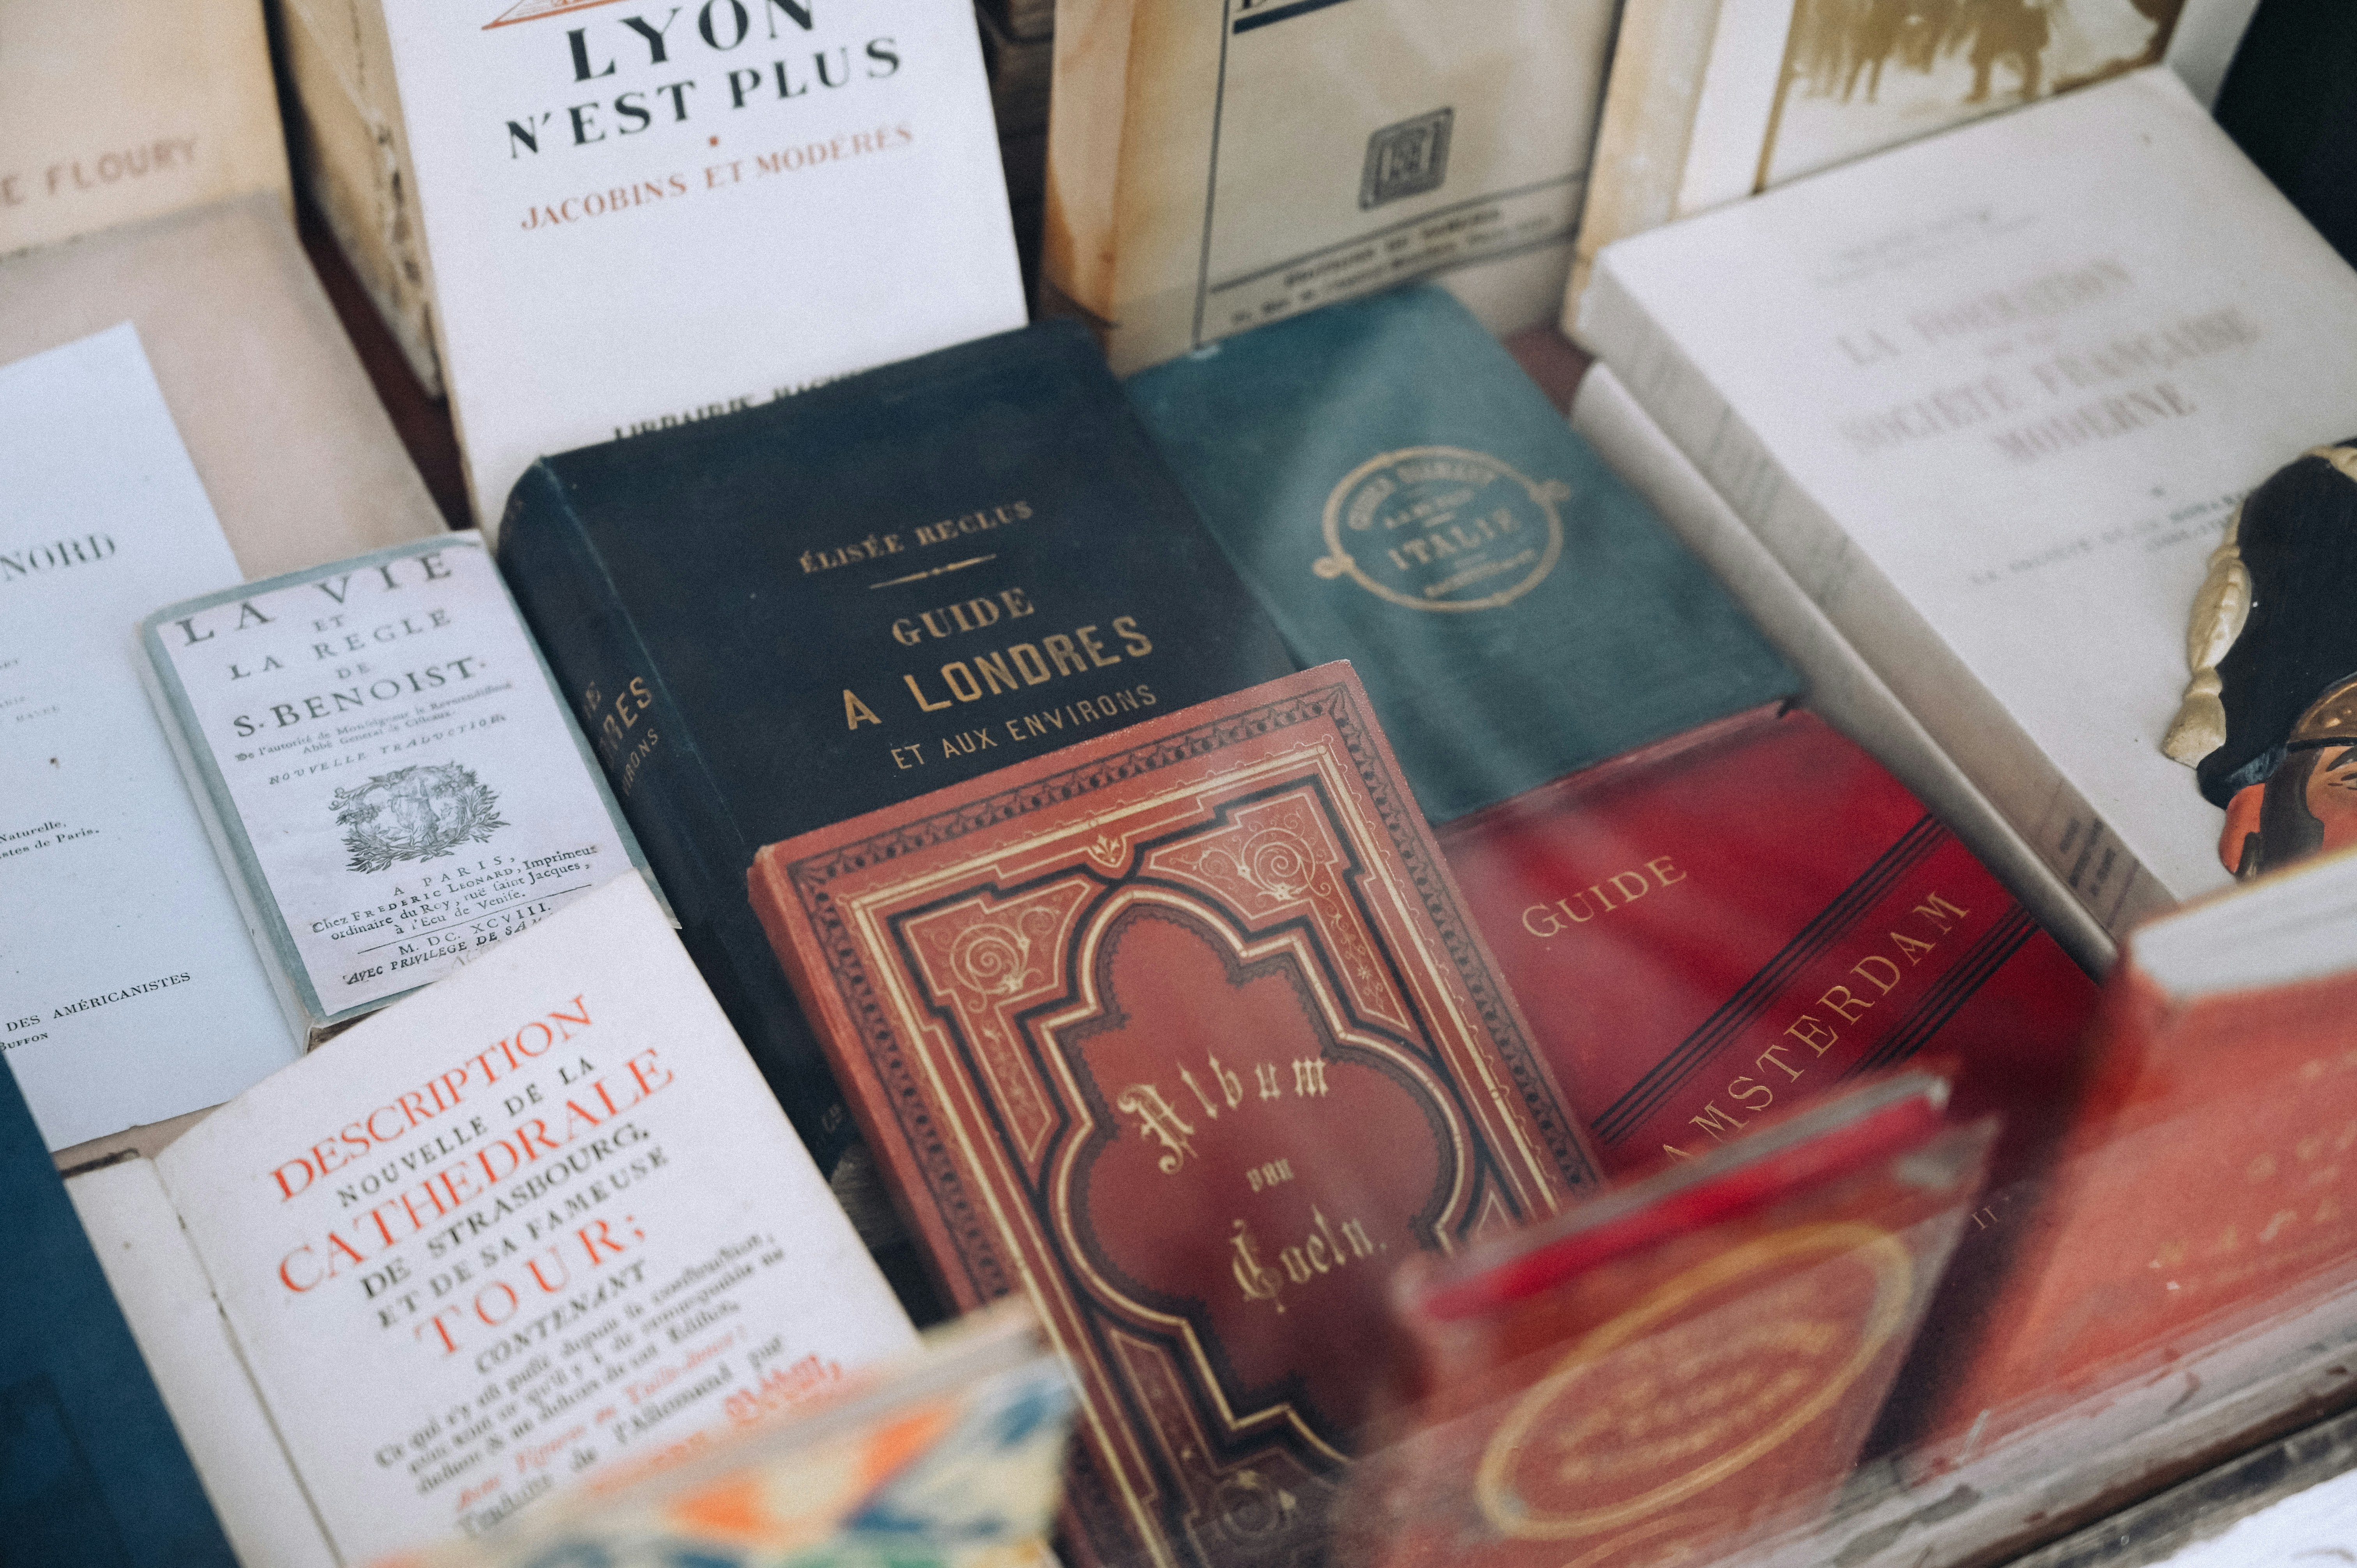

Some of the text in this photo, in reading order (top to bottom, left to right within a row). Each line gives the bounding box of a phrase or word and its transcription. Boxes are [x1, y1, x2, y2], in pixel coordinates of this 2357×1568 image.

[565, 0, 815, 83] LYON
[505, 37, 901, 159] N'EST PLUS
[521, 173, 688, 231] JACOBINS
[703, 162, 745, 190] ET
[0, 533, 116, 582] NORD
[799, 500, 1035, 574] ÉLISÉE RECLUS
[175, 551, 453, 646] LA VIE
[314, 613, 345, 634] ET
[891, 587, 1035, 646] GUIDE
[227, 607, 453, 680] LA REGLE
[337, 661, 373, 680] DE
[842, 616, 1153, 731] A LONDRES
[890, 684, 1158, 770] ET AUX ENVIRONS
[0, 828, 99, 858] stes de Paris.
[312, 917, 349, 934] Chez
[352, 890, 442, 921] FREDERIC
[331, 915, 394, 941] ordinaire
[400, 906, 418, 921] du
[393, 886, 405, 897] A
[395, 924, 405, 936] à
[453, 905, 470, 918] de
[1521, 855, 1688, 938] GUIDE
[345, 965, 384, 985] AVEC
[390, 941, 468, 972] PRIVILEGE
[475, 931, 499, 947] DE
[398, 943, 419, 956] M.
[5, 971, 191, 1032] DES AMÉRICANISTES
[268, 994, 594, 1204] DESCRIPTION
[336, 1056, 597, 1209] NOUVELLE DE LA
[1117, 1048, 1329, 1174] Album
[278, 1046, 675, 1294] CATHEDRALE
[376, 1145, 671, 1329] ET DE SA FAMEUSE
[358, 1258, 412, 1300] DE
[412, 1213, 648, 1356] TOUR;
[475, 1259, 647, 1376] CONTENANT
